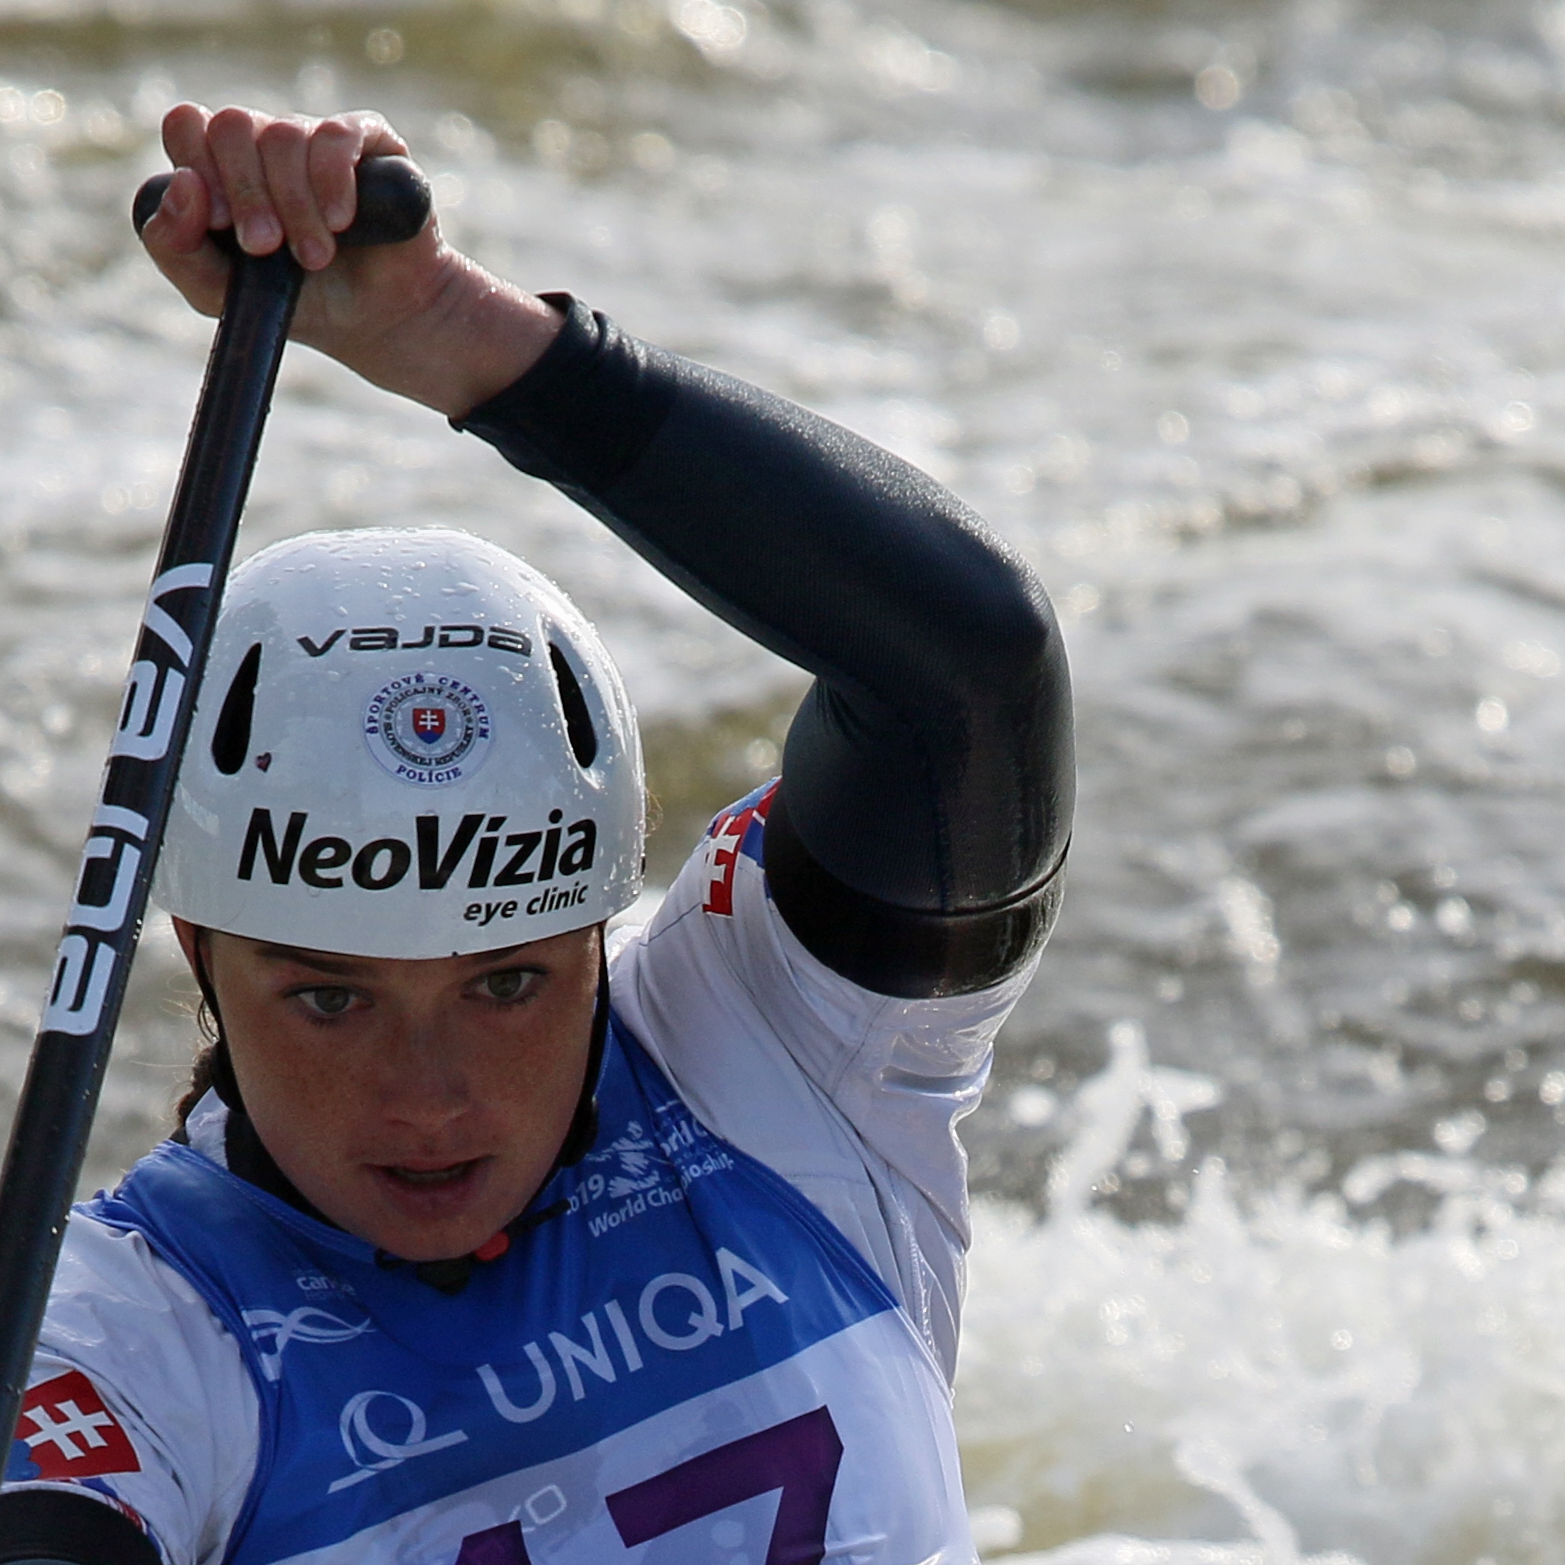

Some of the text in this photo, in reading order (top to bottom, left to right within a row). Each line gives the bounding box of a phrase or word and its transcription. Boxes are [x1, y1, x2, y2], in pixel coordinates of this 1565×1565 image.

[438, 676, 490, 740] CENTRUM
[463, 881, 589, 926] eye clinic
[566, 1173, 606, 1216] 019
[588, 1192, 647, 1238] World
[476, 1247, 788, 1424] UNIQA
